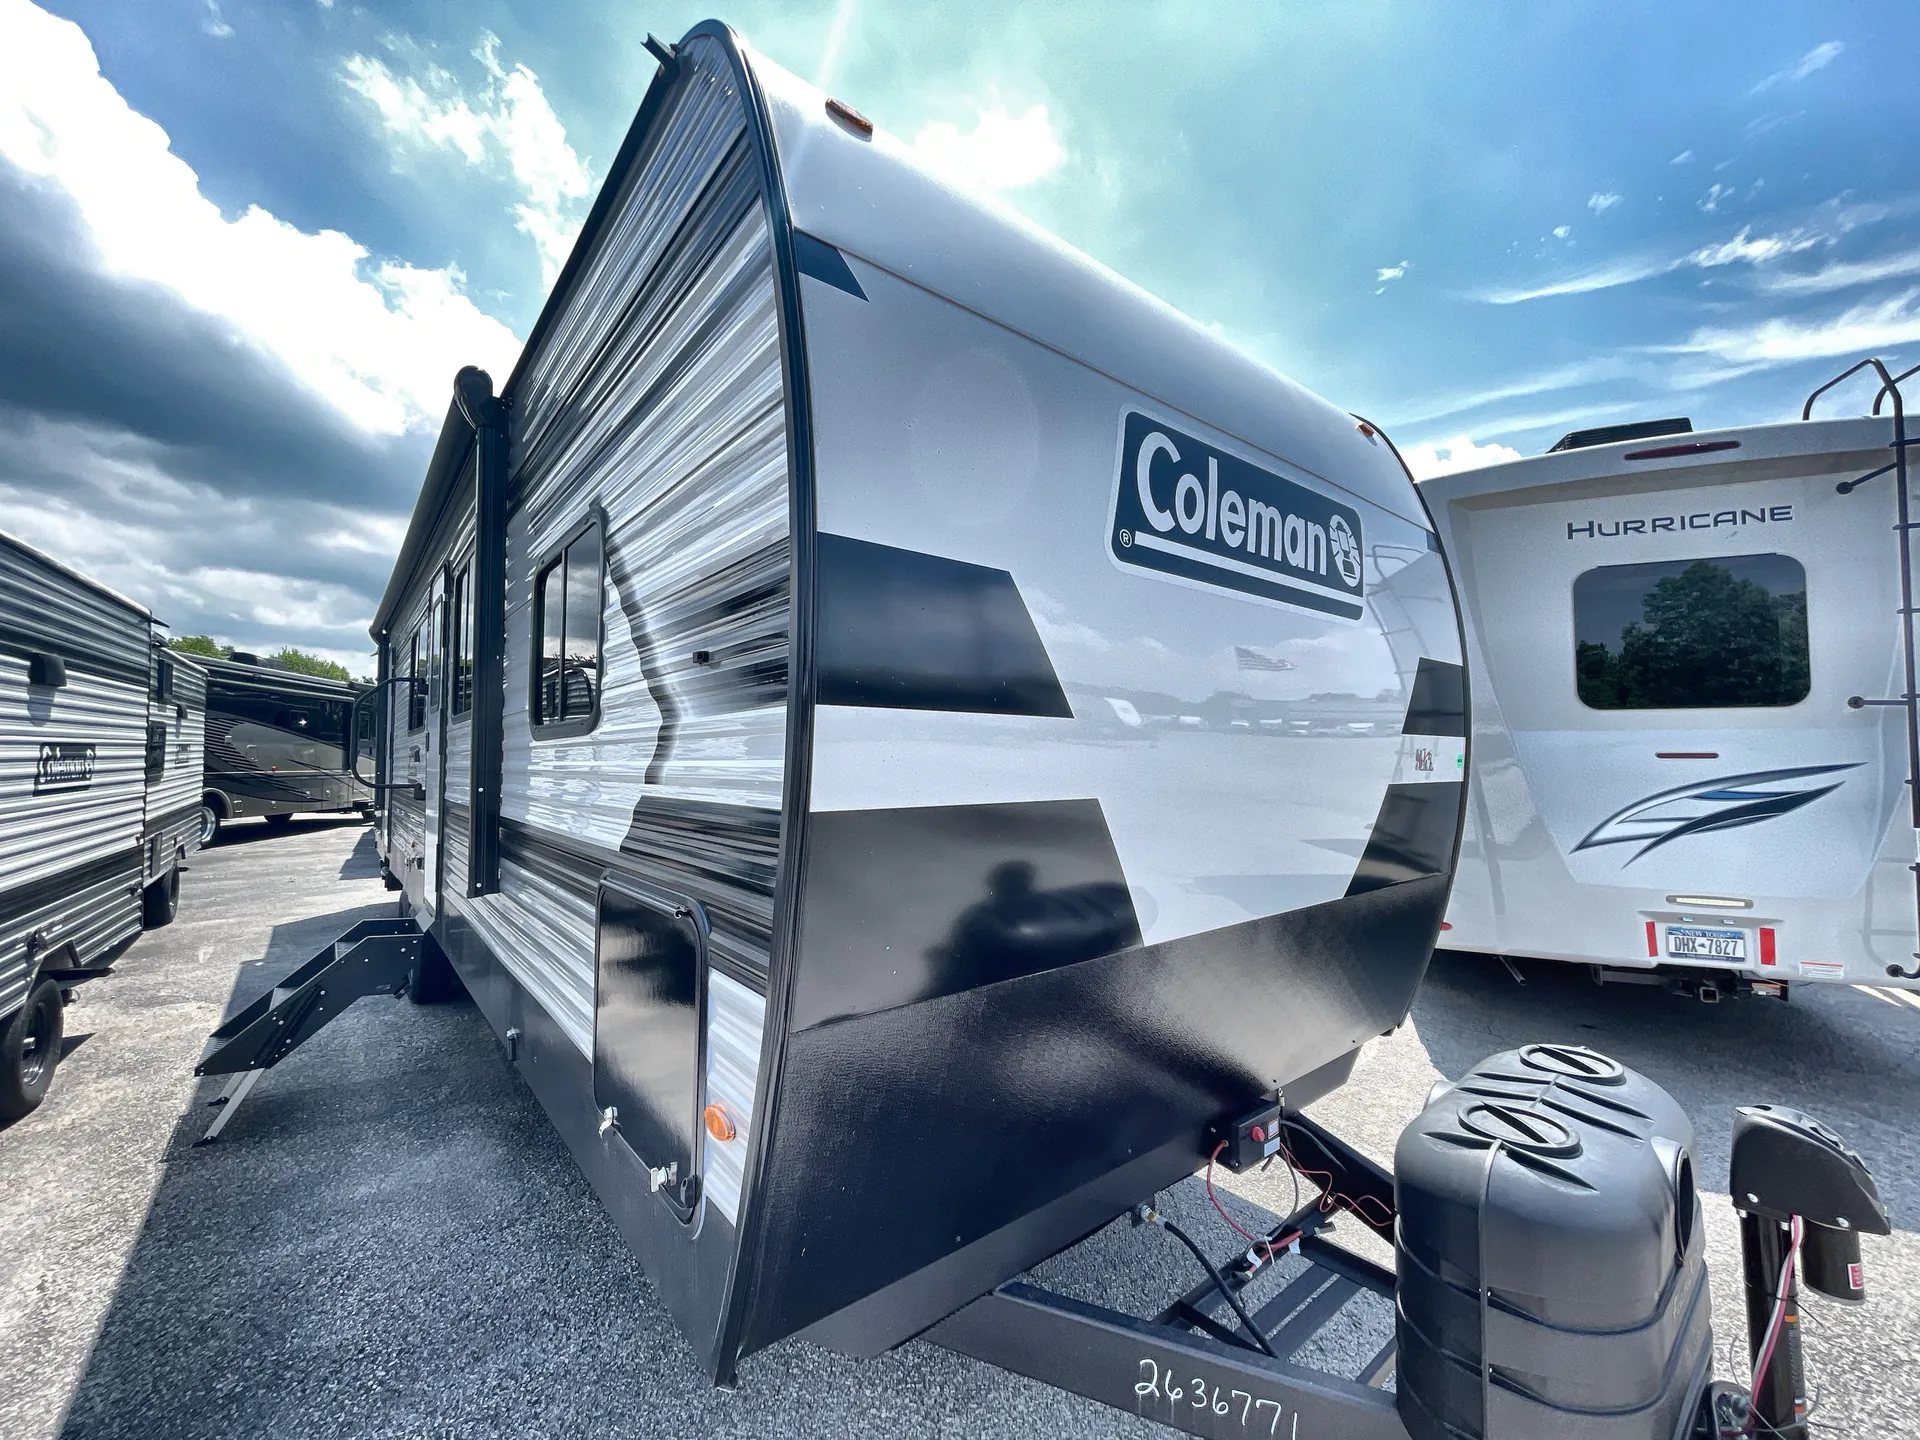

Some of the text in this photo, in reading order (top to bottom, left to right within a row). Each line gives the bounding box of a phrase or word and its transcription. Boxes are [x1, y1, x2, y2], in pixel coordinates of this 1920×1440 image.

[1136, 431, 1327, 576] Coleman
[1567, 505, 1793, 540] HURRICANE
[39, 745, 85, 783] Coleman
[1134, 1359, 1298, 1440] 2636771
